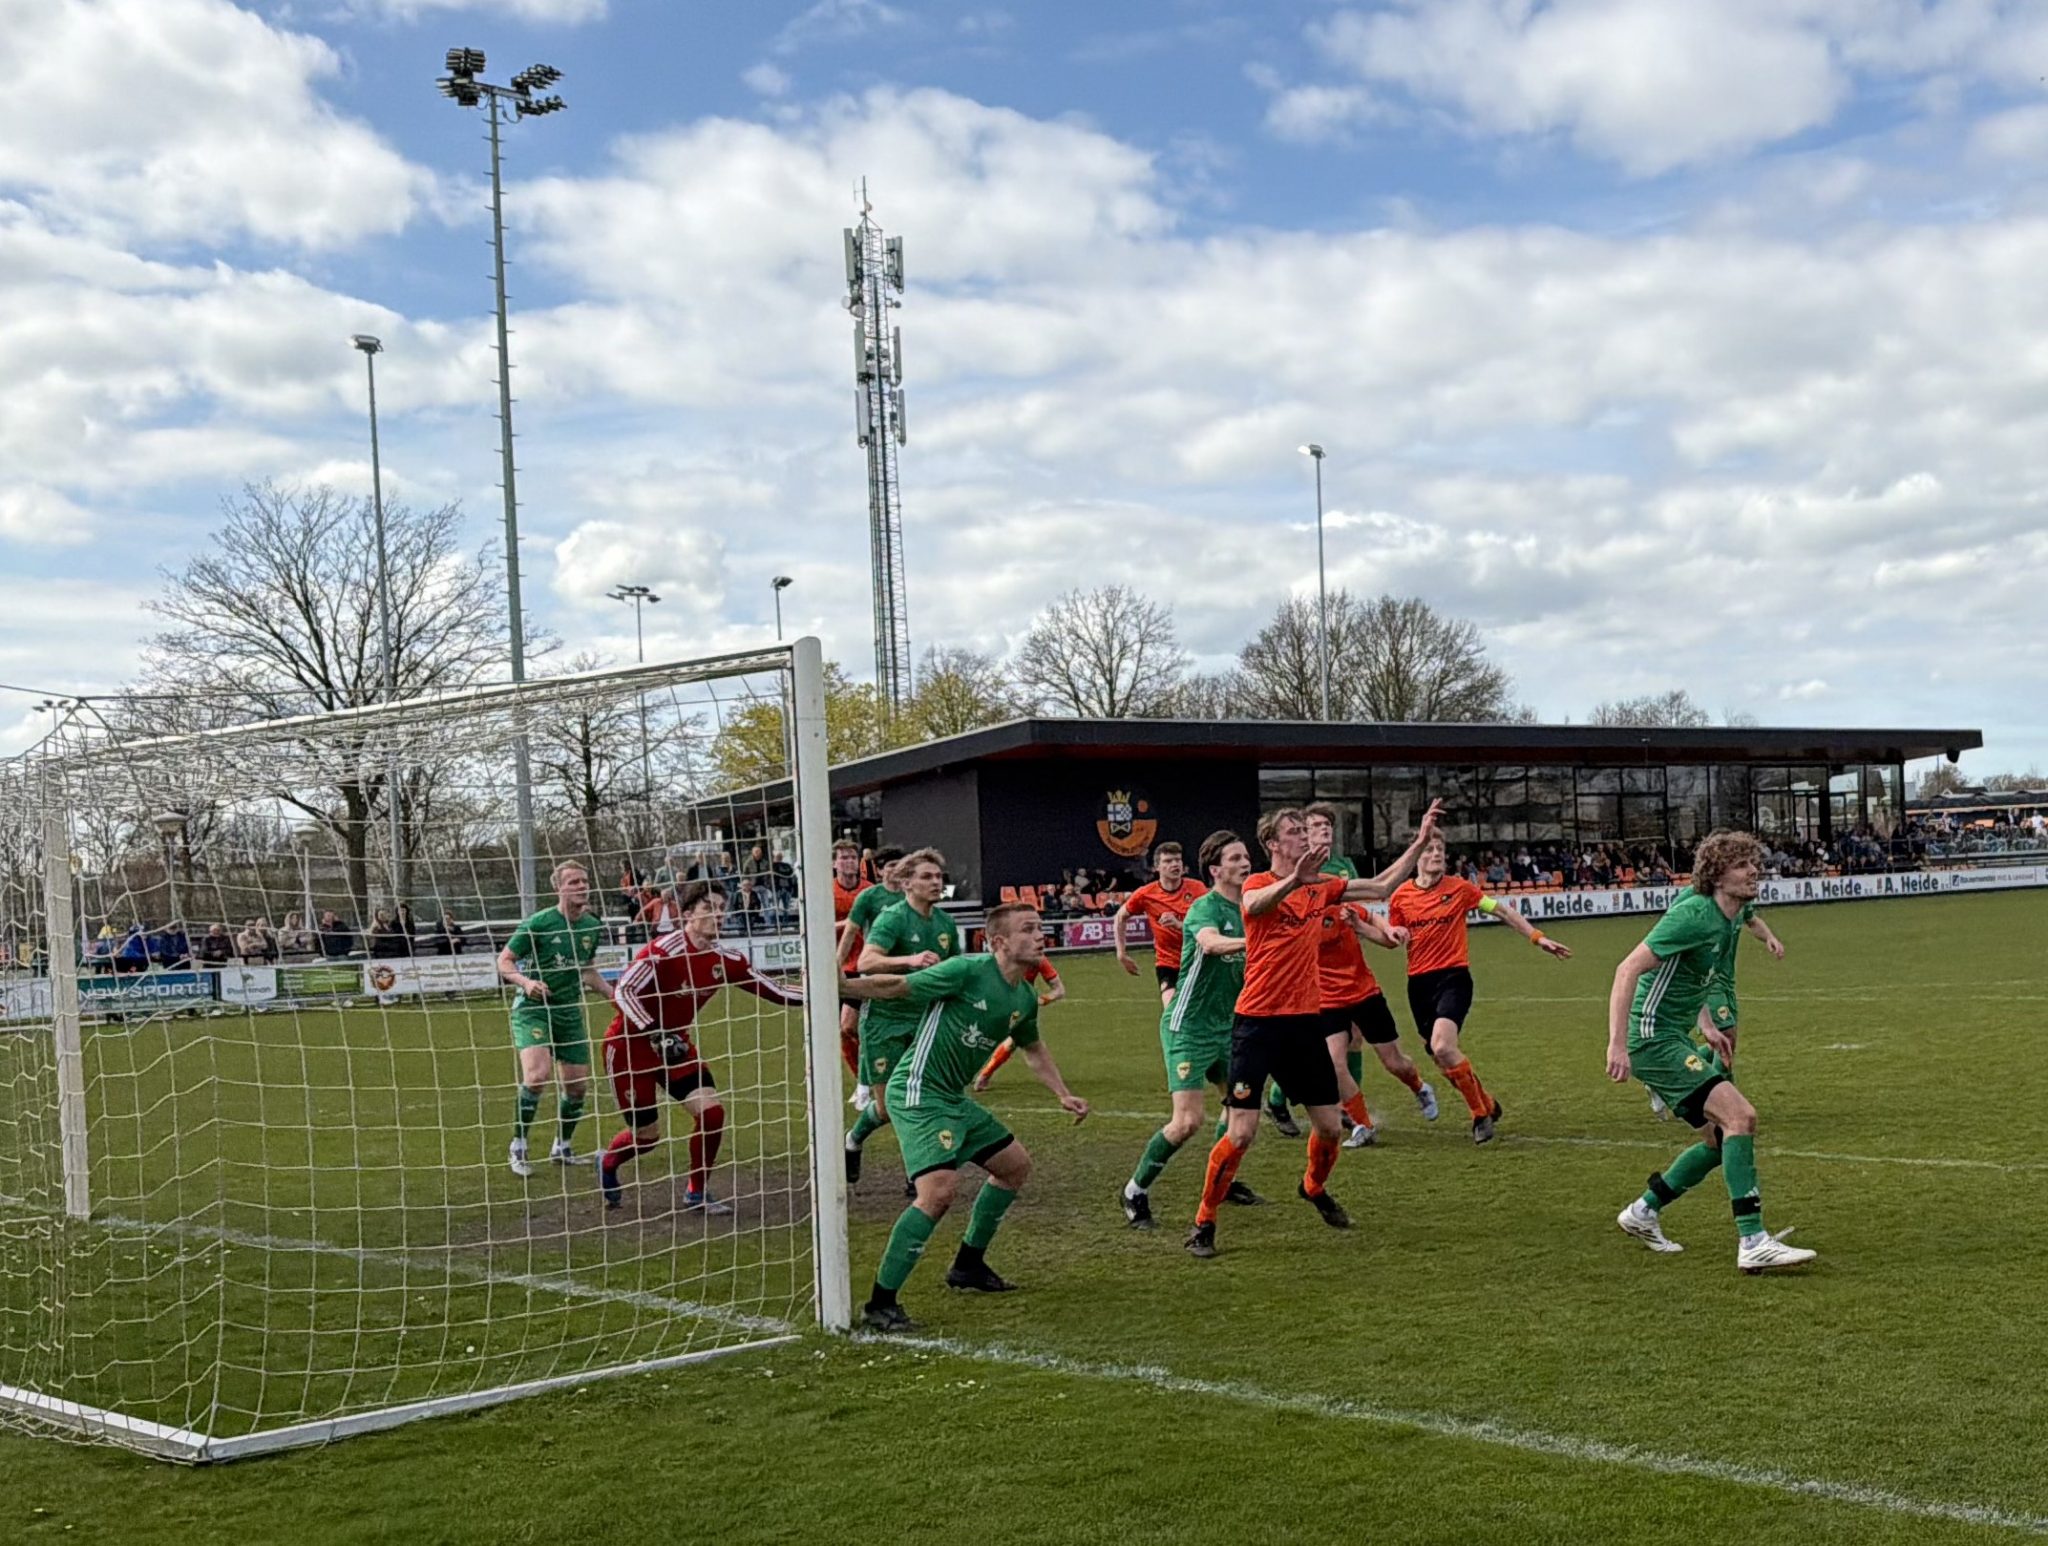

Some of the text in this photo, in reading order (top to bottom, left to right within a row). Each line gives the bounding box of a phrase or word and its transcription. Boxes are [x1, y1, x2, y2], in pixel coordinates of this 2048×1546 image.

[1804, 881, 1818, 899] A.
[1822, 879, 1862, 897] Heide
[1885, 877, 1898, 893] A.
[1901, 874, 1939, 892] Heide
[1520, 898, 1540, 917] A.
[1543, 894, 1594, 915] Heide
[1622, 892, 1640, 911] A.
[1643, 889, 1680, 909] Heid
